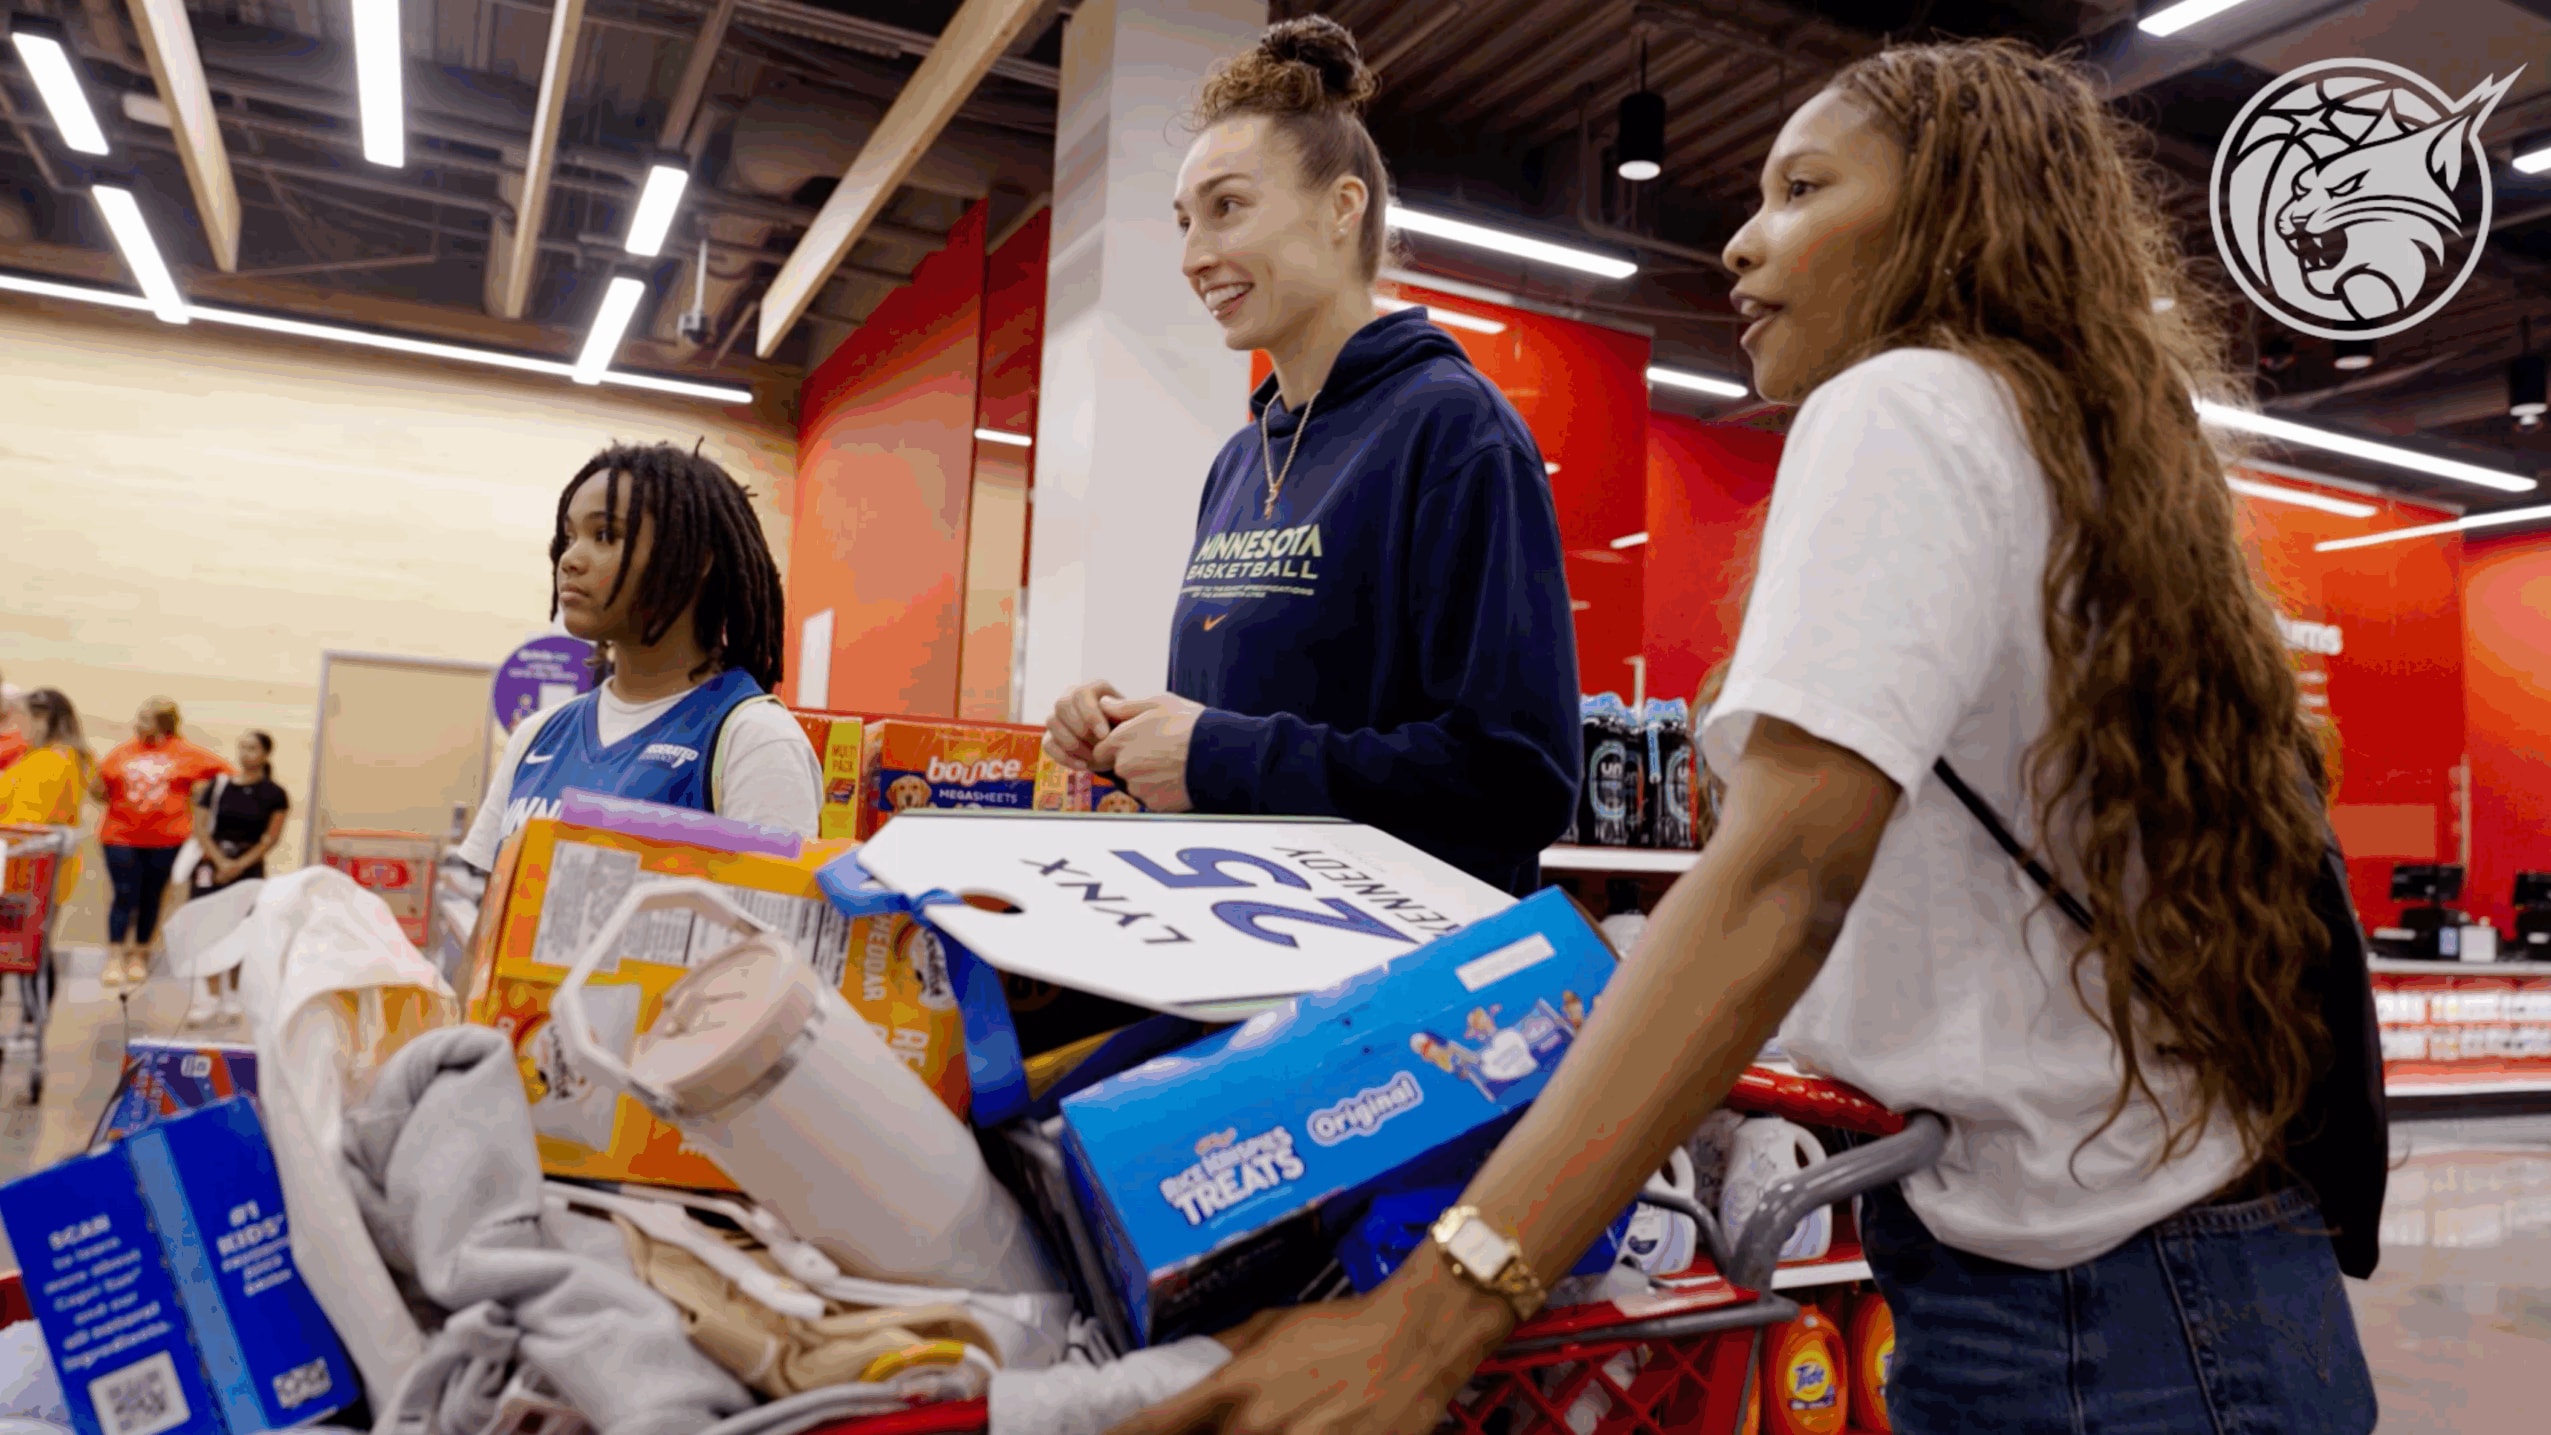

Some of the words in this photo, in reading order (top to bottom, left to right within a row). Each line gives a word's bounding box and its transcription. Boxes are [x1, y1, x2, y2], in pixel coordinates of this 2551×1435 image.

[1195, 523, 1322, 562] MINNESOTA
[1186, 560, 1319, 580] BASKETBALL
[926, 756, 1022, 786] bounce
[939, 788, 1018, 804] MEGASHEETS
[1019, 858, 1195, 946] LYNX
[1108, 846, 1423, 950] 25
[863, 913, 893, 1001] HEDDAR
[1314, 1079, 1416, 1138] Original
[1175, 1150, 1304, 1225] TREATS
[1795, 1363, 1825, 1393] Tide
